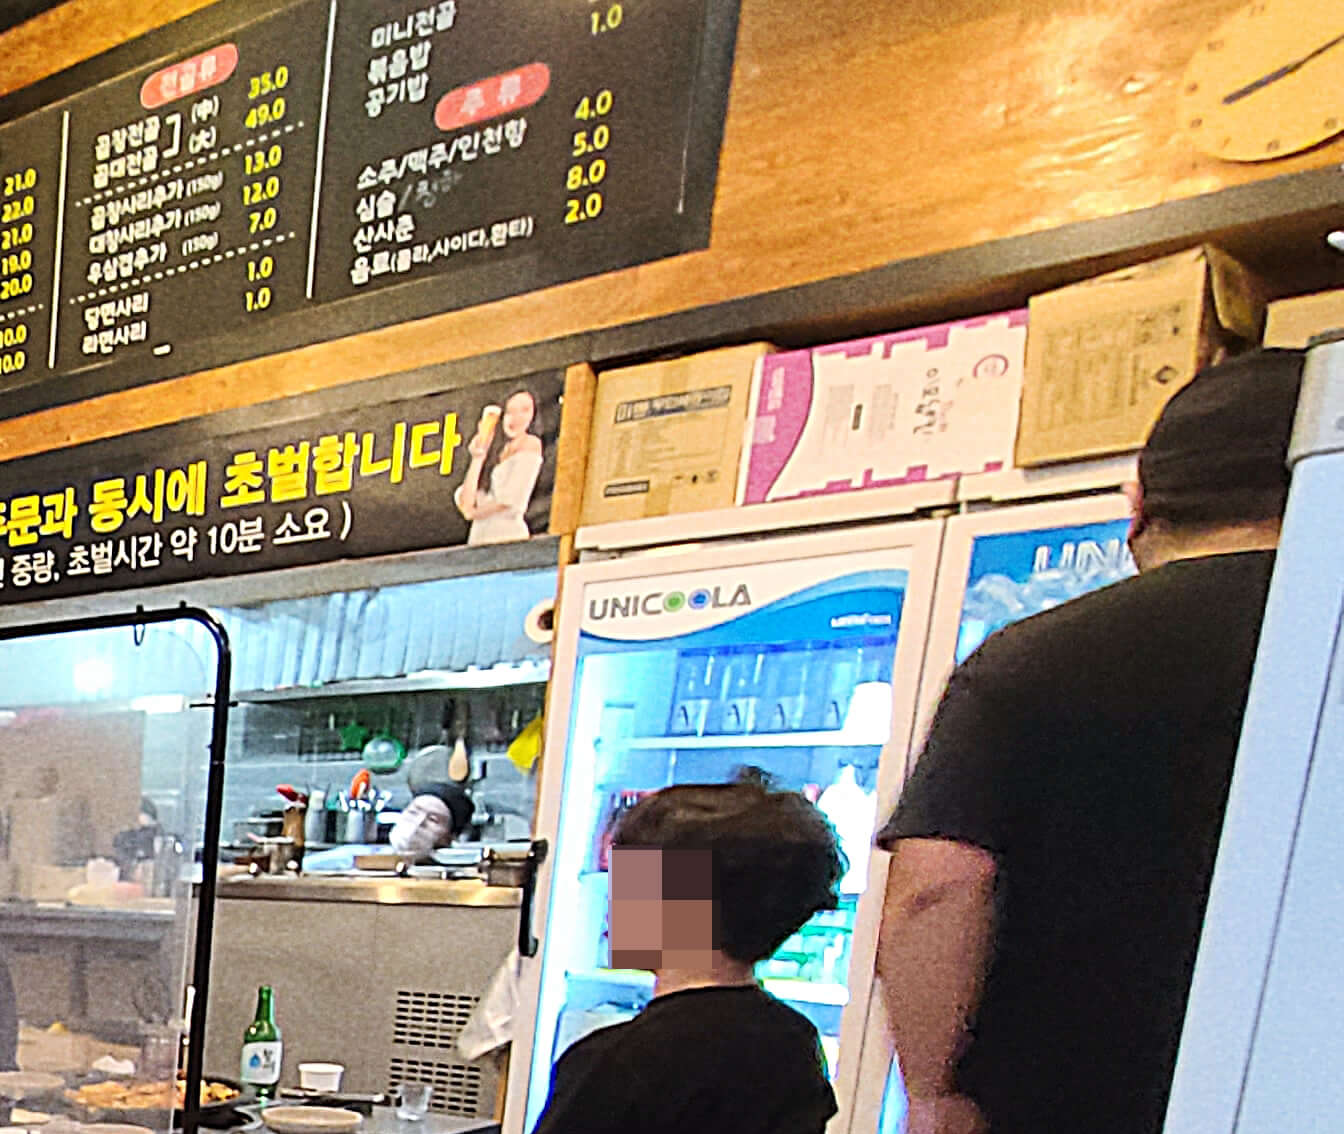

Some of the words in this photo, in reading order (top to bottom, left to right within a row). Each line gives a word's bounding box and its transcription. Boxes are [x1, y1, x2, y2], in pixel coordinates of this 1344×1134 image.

[371, 1, 456, 49] 미니전골
[365, 73, 429, 118] 공기밥
[591, 4, 623, 36] 1.0
[248, 65, 288, 100] 35.0
[244, 97, 286, 128] 49.0
[575, 90, 613, 120] 4.0
[572, 125, 610, 157] 5.0
[244, 144, 283, 175] 13.0
[3, 168, 37, 196] 21.0
[243, 176, 280, 206] 12.0
[1, 195, 35, 223] 22.0
[249, 207, 278, 234] 7.0
[353, 213, 416, 254] 산사춘
[566, 158, 607, 191] 8.0
[564, 191, 603, 224] 2.0
[1, 223, 33, 251] 21.0
[1, 250, 32, 276] 19.0
[0, 273, 33, 300] 20.0
[84, 292, 149, 331] 당면사리
[247, 256, 274, 282] 1.0
[82, 320, 147, 354] 라면사리
[245, 287, 272, 313] 1.0
[88, 460, 208, 534] 동시에
[220, 411, 462, 510] 초벌합니다
[67, 529, 164, 578] 초벌시간
[170, 523, 198, 562] 약
[207, 516, 265, 556] 10분
